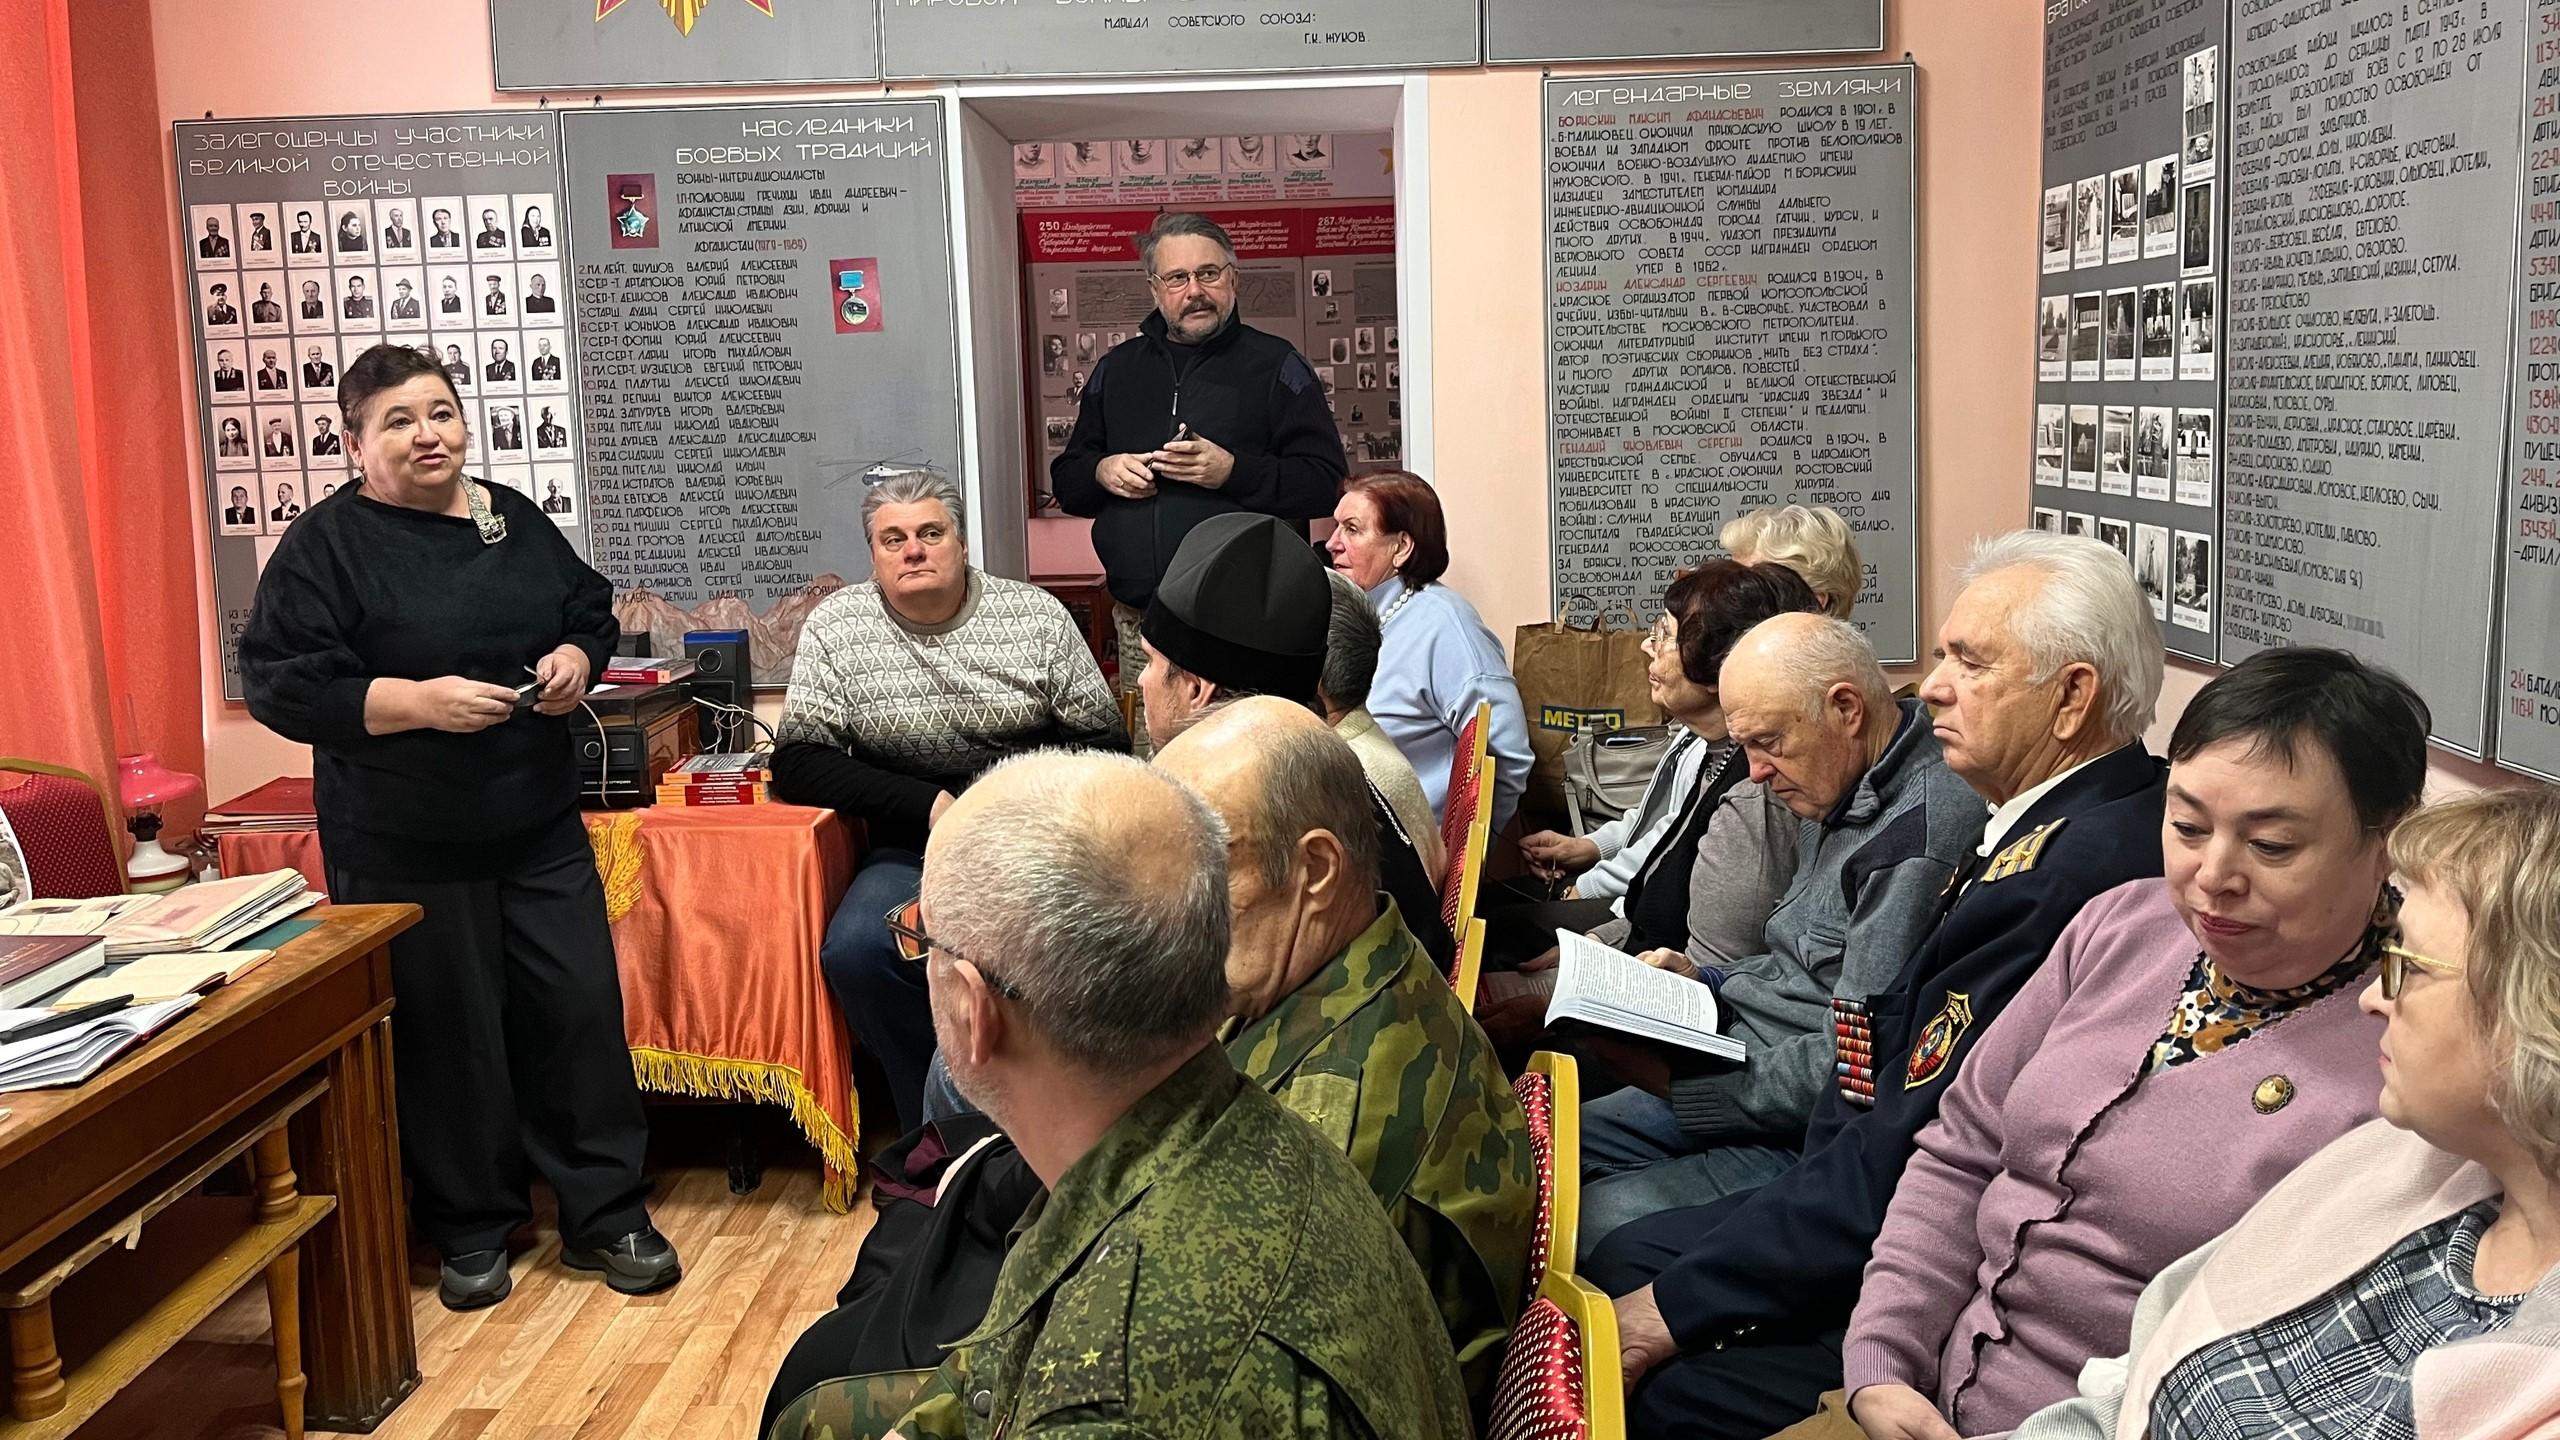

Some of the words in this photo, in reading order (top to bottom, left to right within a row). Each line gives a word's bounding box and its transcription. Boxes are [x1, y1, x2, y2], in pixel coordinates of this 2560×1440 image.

[1168, 15, 1245, 27] СОВЕТСКОГО
[1039, 222, 1059, 230] 250
[668, 303, 705, 315] СЕРГЕЙ
[1544, 709, 1621, 731] METO
